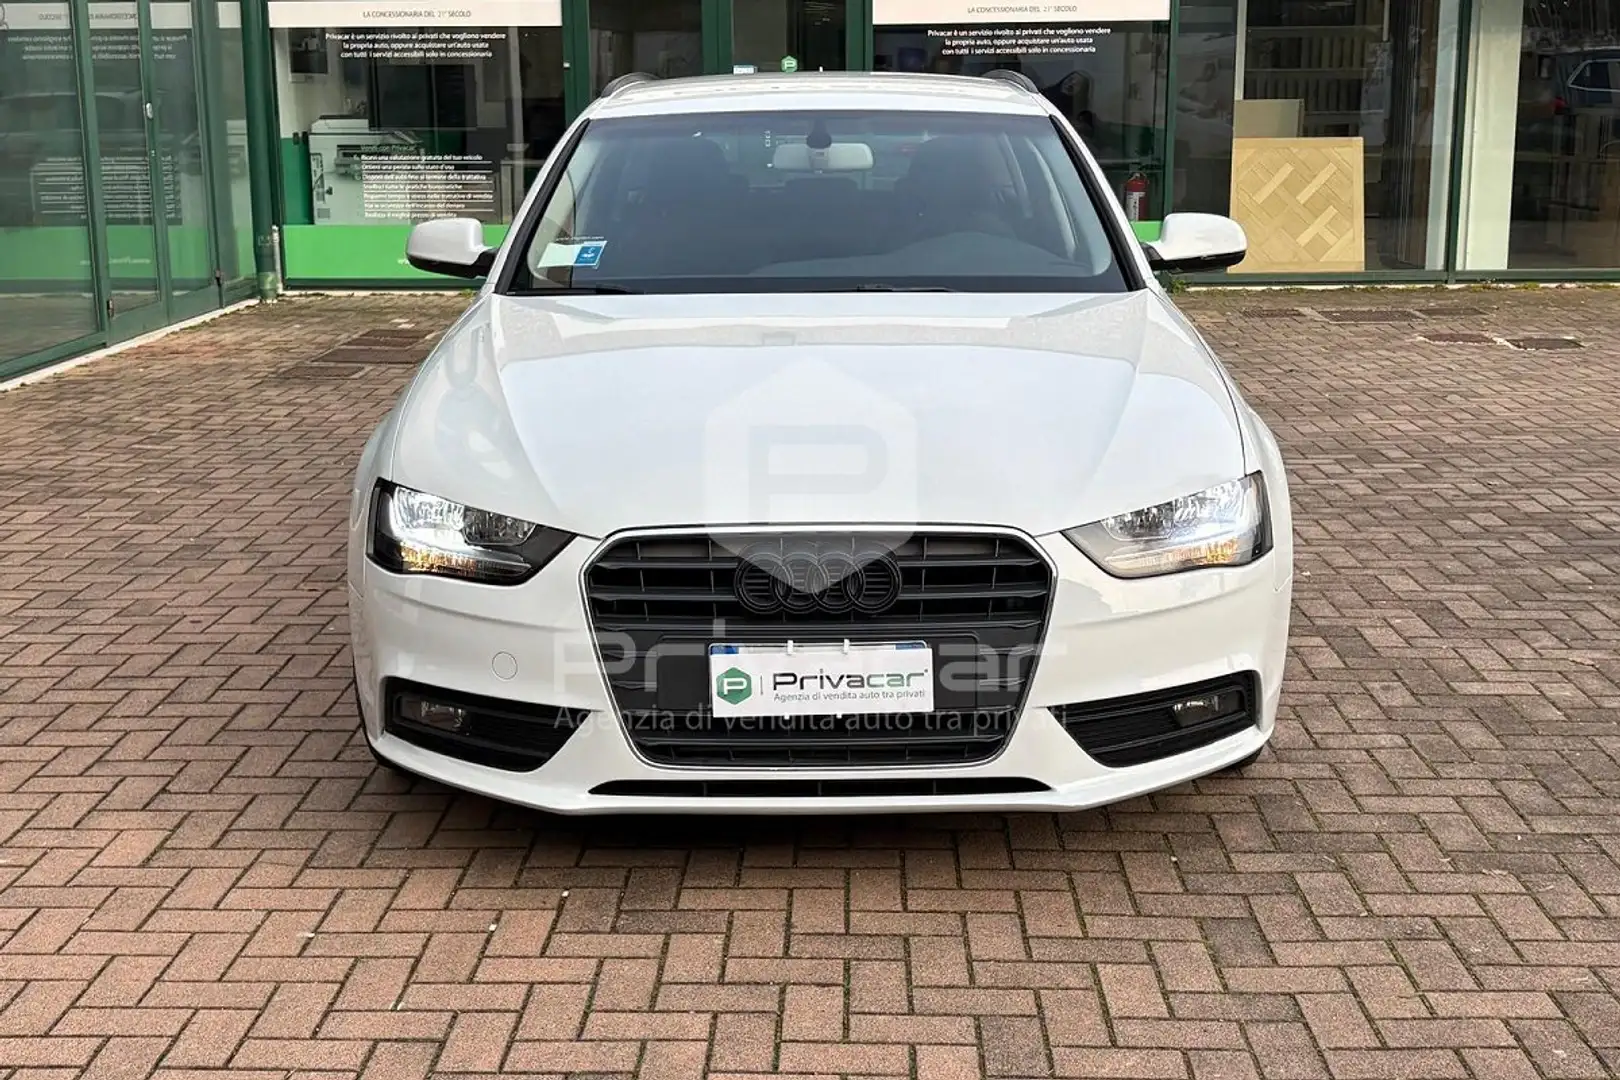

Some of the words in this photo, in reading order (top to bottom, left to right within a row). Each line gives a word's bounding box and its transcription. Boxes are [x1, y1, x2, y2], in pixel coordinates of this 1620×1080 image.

[1056, 27, 1084, 36] vogliono
[952, 39, 975, 47] propria
[724, 678, 748, 694] P
[773, 669, 925, 691] Privacar
[774, 692, 810, 703] Agenzia
[812, 692, 821, 700] di
[824, 691, 856, 700] vendita
[859, 691, 880, 699] auto
[882, 690, 895, 699] tra
[897, 689, 925, 699] privati
